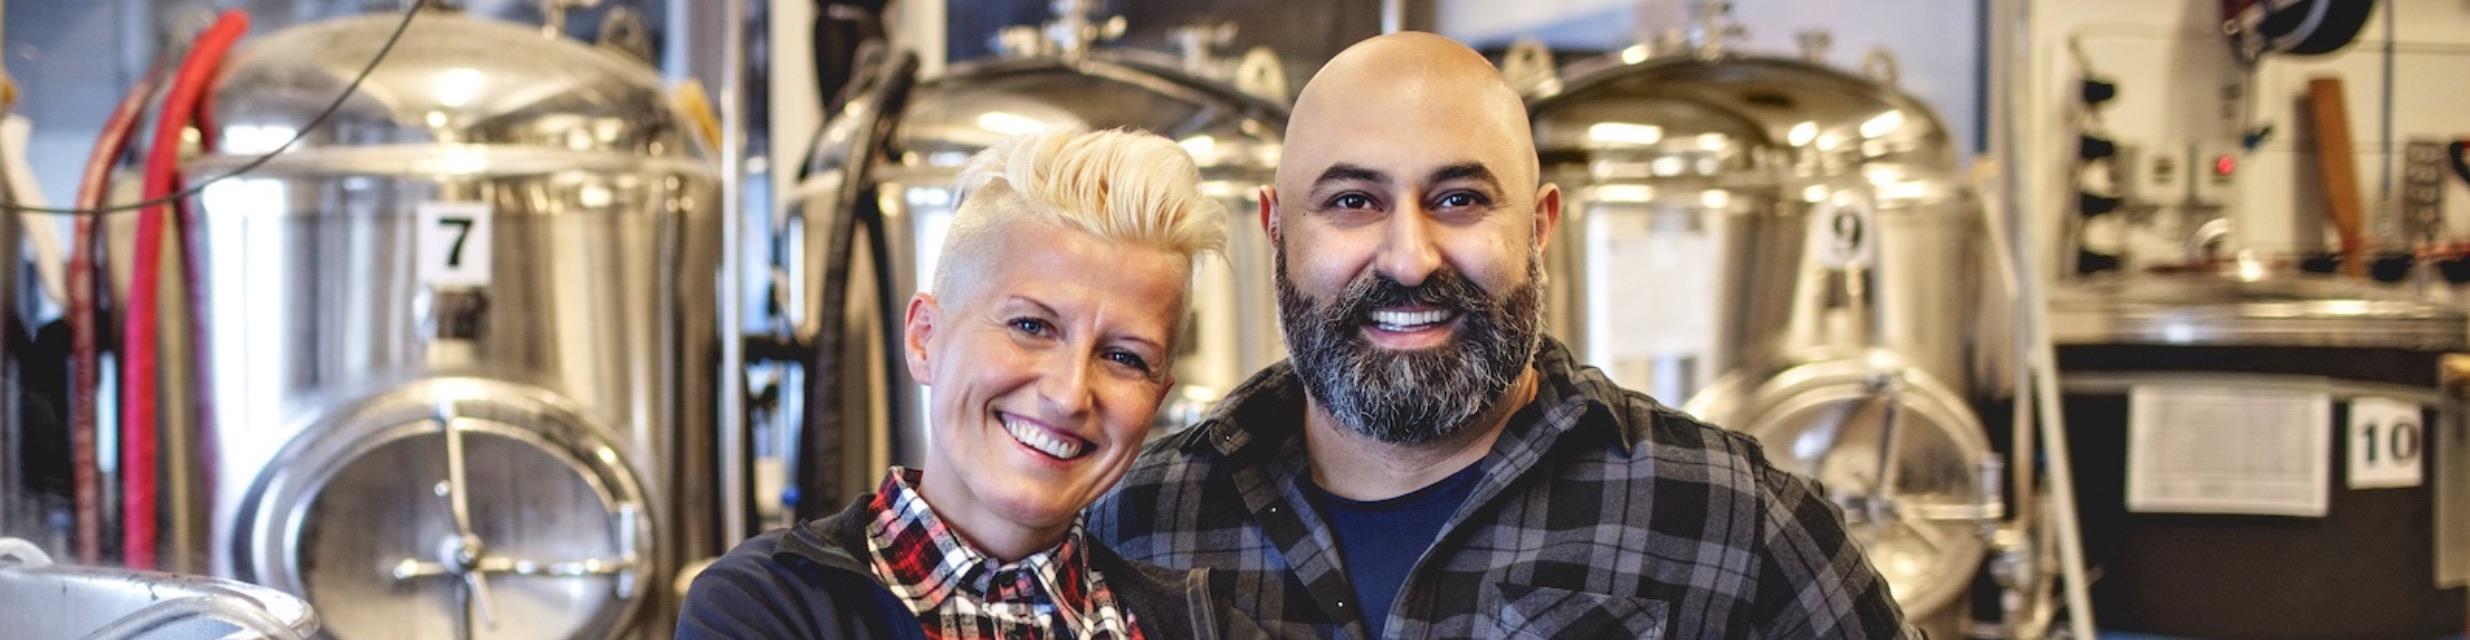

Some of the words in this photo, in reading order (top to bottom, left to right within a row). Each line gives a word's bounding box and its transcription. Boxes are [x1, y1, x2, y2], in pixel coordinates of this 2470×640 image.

[437, 217, 474, 267] 7
[1832, 209, 1863, 256] 9
[2361, 420, 2420, 466] 10
